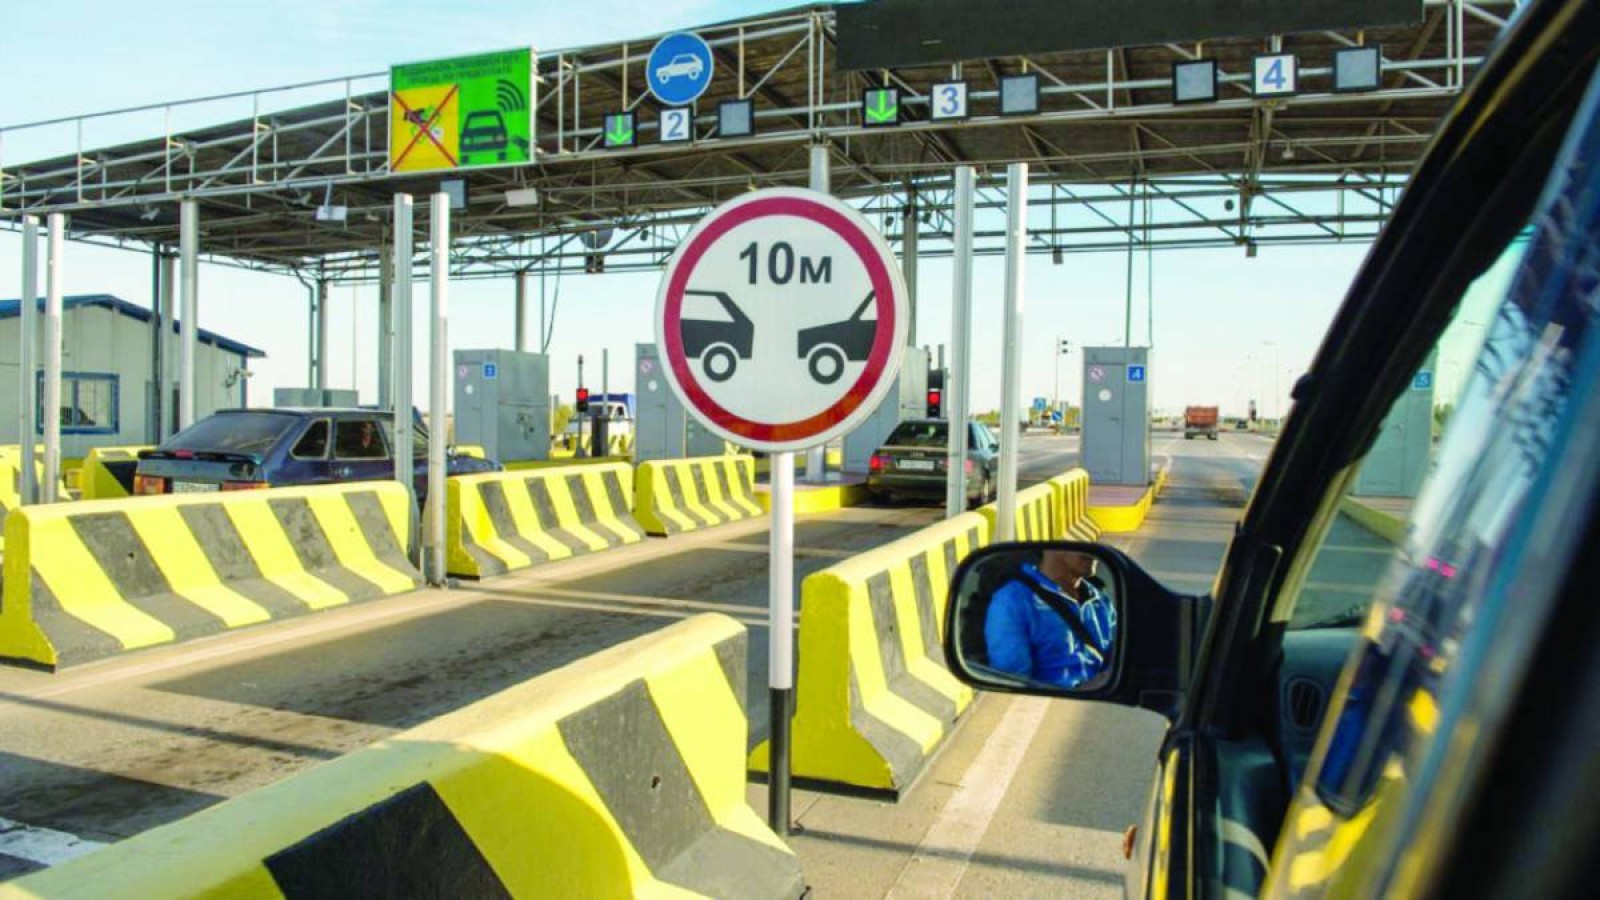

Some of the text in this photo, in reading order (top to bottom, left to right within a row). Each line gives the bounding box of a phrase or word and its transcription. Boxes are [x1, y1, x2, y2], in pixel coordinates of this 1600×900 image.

[1263, 58, 1286, 89] 4
[941, 86, 959, 115] 3
[667, 111, 683, 138] 2
